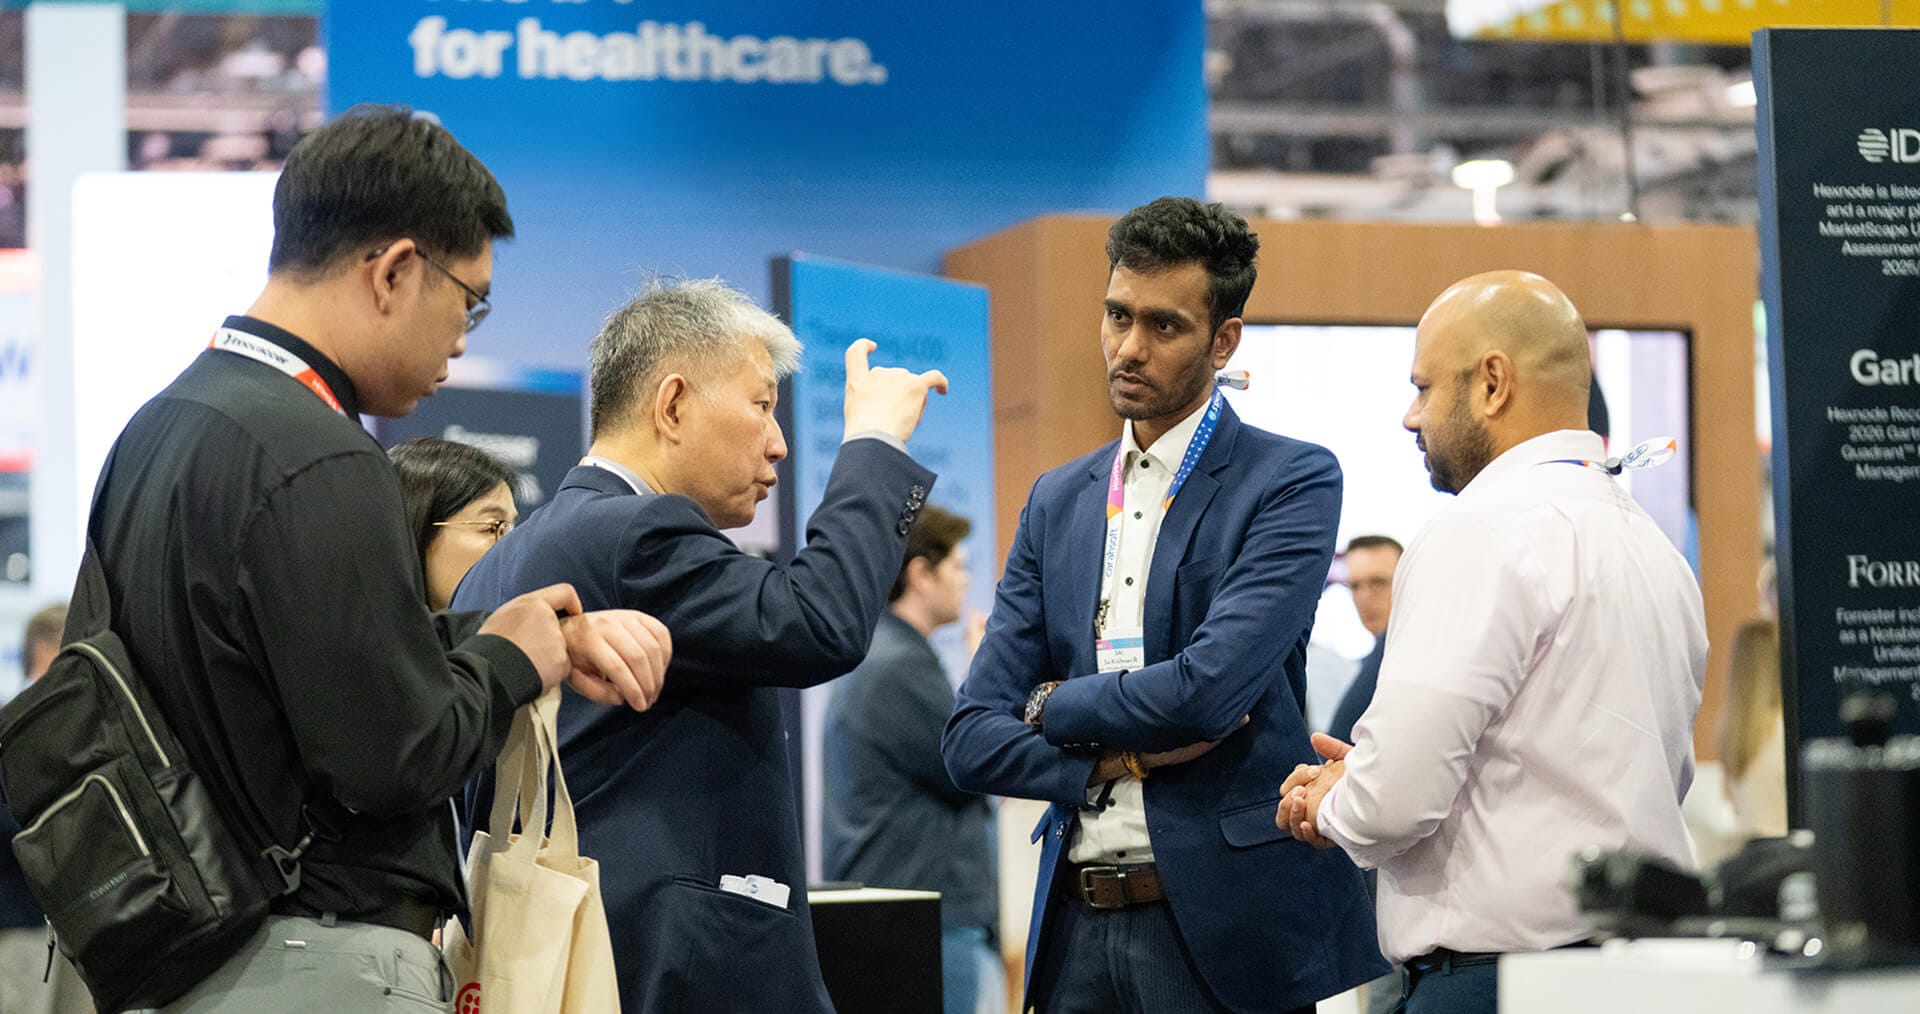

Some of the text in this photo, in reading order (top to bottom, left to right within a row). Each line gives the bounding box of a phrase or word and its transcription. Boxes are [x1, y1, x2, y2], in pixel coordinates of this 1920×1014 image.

[408, 15, 889, 85] for healthcare.
[1813, 183, 1874, 199] Hexnode
[1877, 183, 1888, 199] is
[1826, 203, 1854, 218] and
[1856, 205, 1866, 218] a
[1867, 203, 1905, 220] major
[1819, 221, 1909, 240] MarketScape
[1827, 405, 1889, 422] Hexnode
